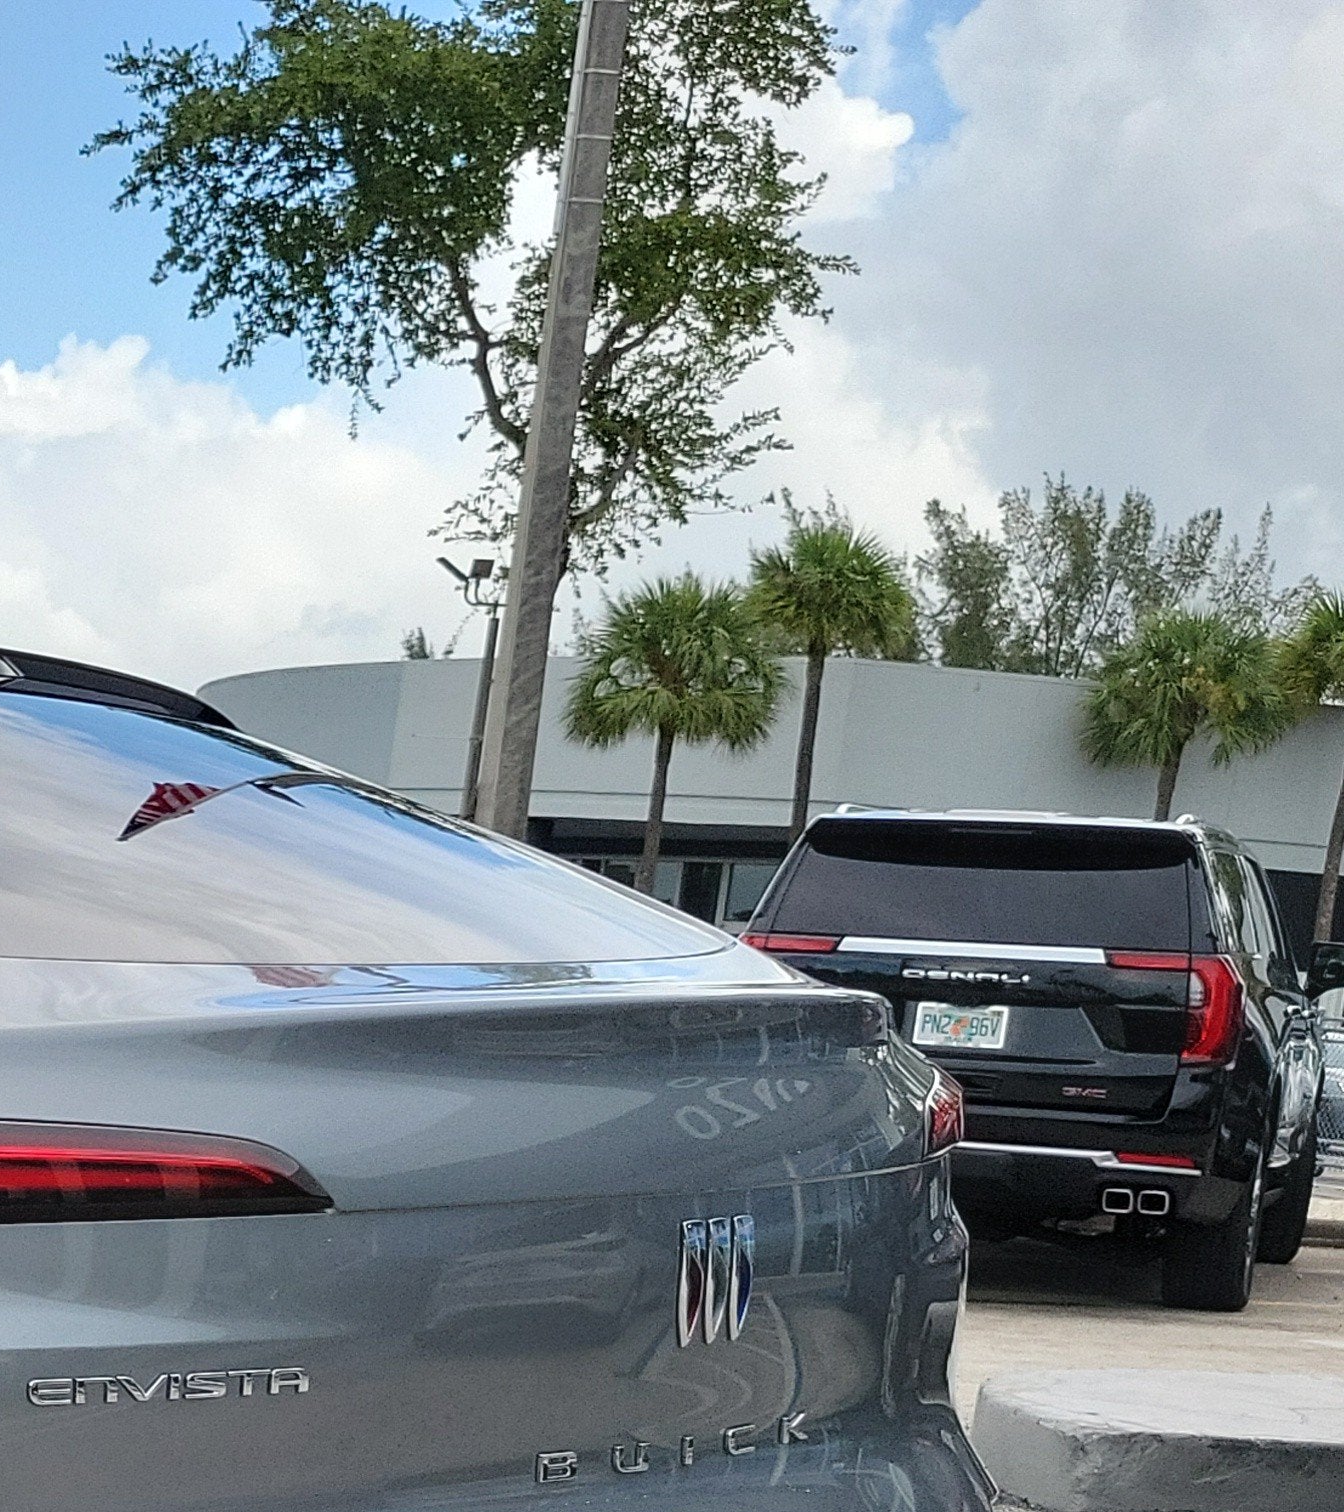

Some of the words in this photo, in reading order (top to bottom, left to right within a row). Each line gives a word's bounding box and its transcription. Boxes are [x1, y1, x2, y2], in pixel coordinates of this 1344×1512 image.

[902, 969, 1030, 983] DENALI
[1063, 1086, 1107, 1098] GMC
[26, 1366, 309, 1407] ENVISTA
[534, 1412, 809, 1484] BUICK
